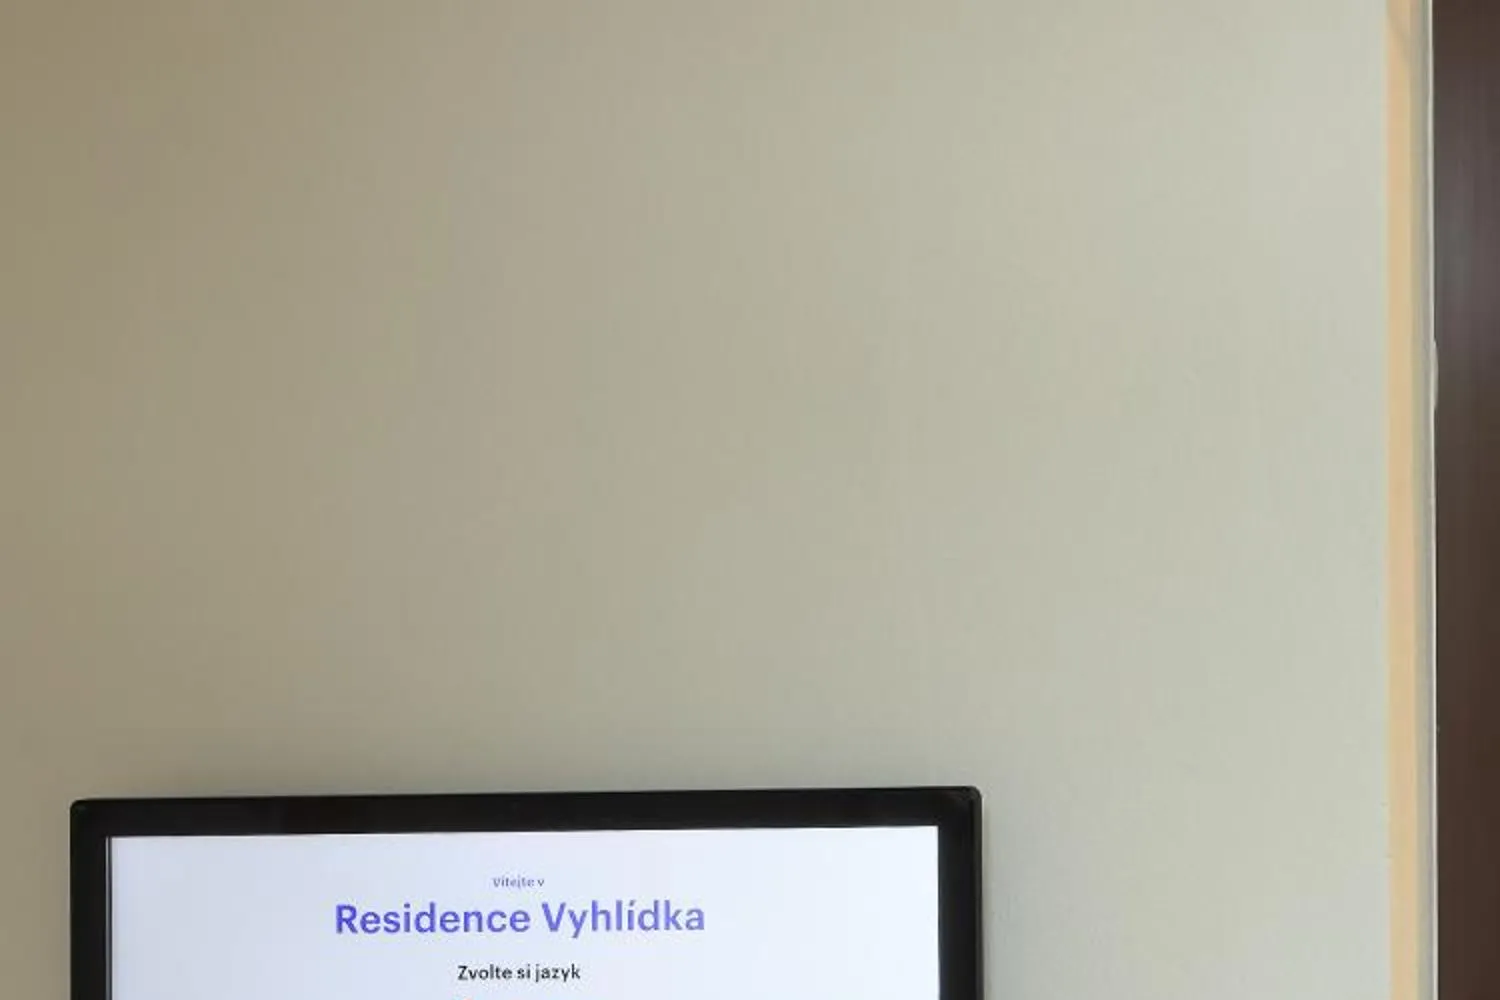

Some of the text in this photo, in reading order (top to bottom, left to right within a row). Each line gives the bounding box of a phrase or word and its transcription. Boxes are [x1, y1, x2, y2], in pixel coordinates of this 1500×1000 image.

[335, 899, 706, 938] Residence Vyhlídka
[457, 963, 581, 982] Zvolte si jazyk
